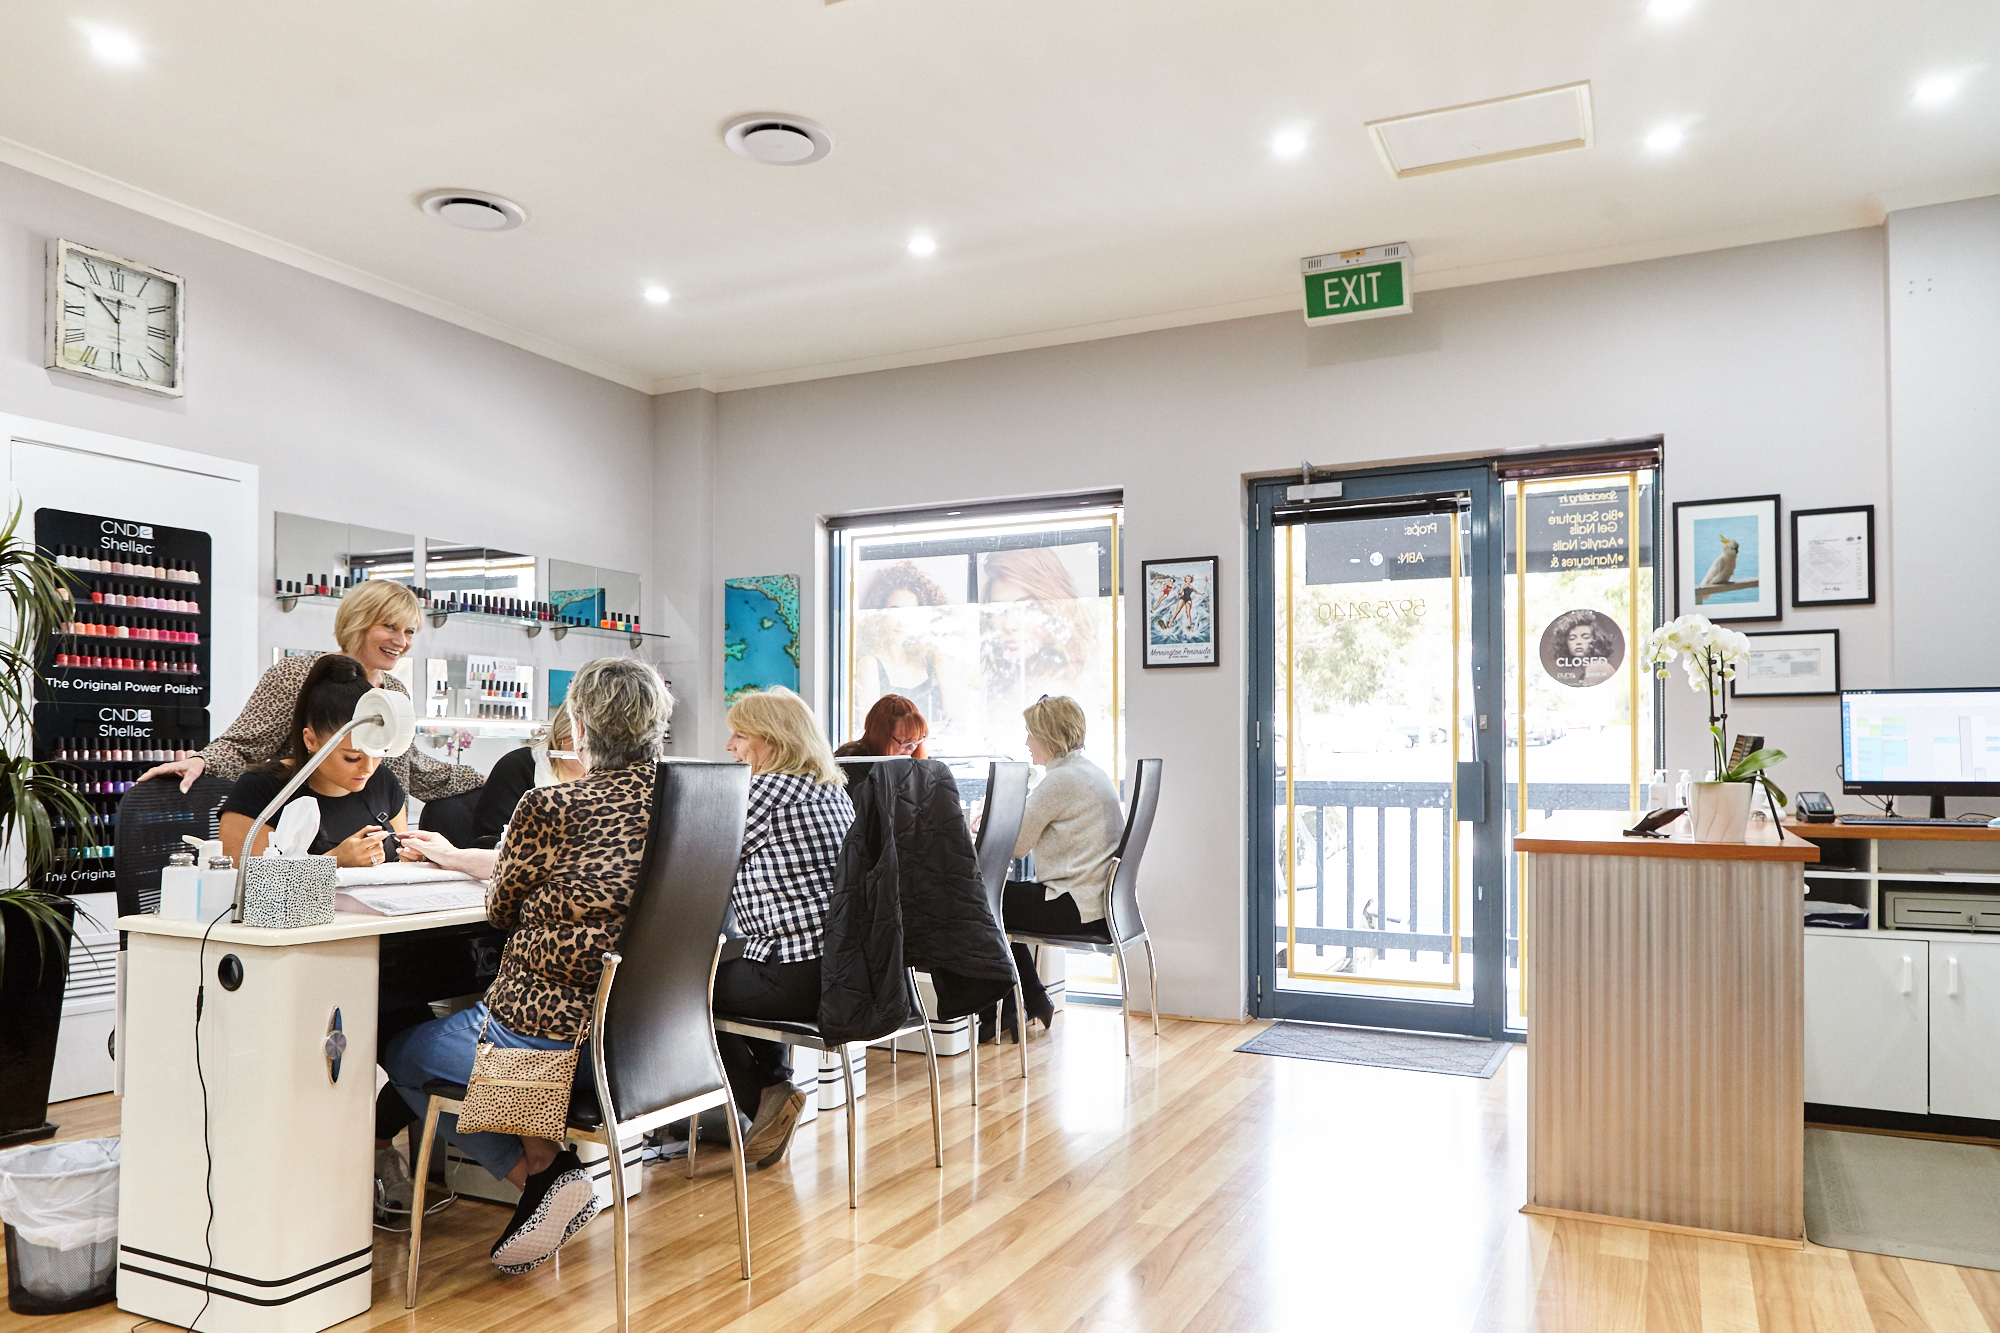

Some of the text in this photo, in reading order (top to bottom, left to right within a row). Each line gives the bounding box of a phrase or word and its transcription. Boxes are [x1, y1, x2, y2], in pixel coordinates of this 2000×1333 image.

[109, 271, 125, 292] XII
[1324, 271, 1382, 310] EXIT
[99, 296, 137, 310] ENSITON
[101, 520, 139, 538] CND
[101, 536, 153, 555] Shellac
[1150, 649, 1182, 659] Mornington
[1183, 646, 1212, 655] Peninsula
[1555, 656, 1608, 668] CLOSED
[46, 677, 198, 695] The Original Power Polish
[99, 707, 138, 723] CND
[99, 724, 150, 738] Shellac
[71, 869, 116, 882] Origina
